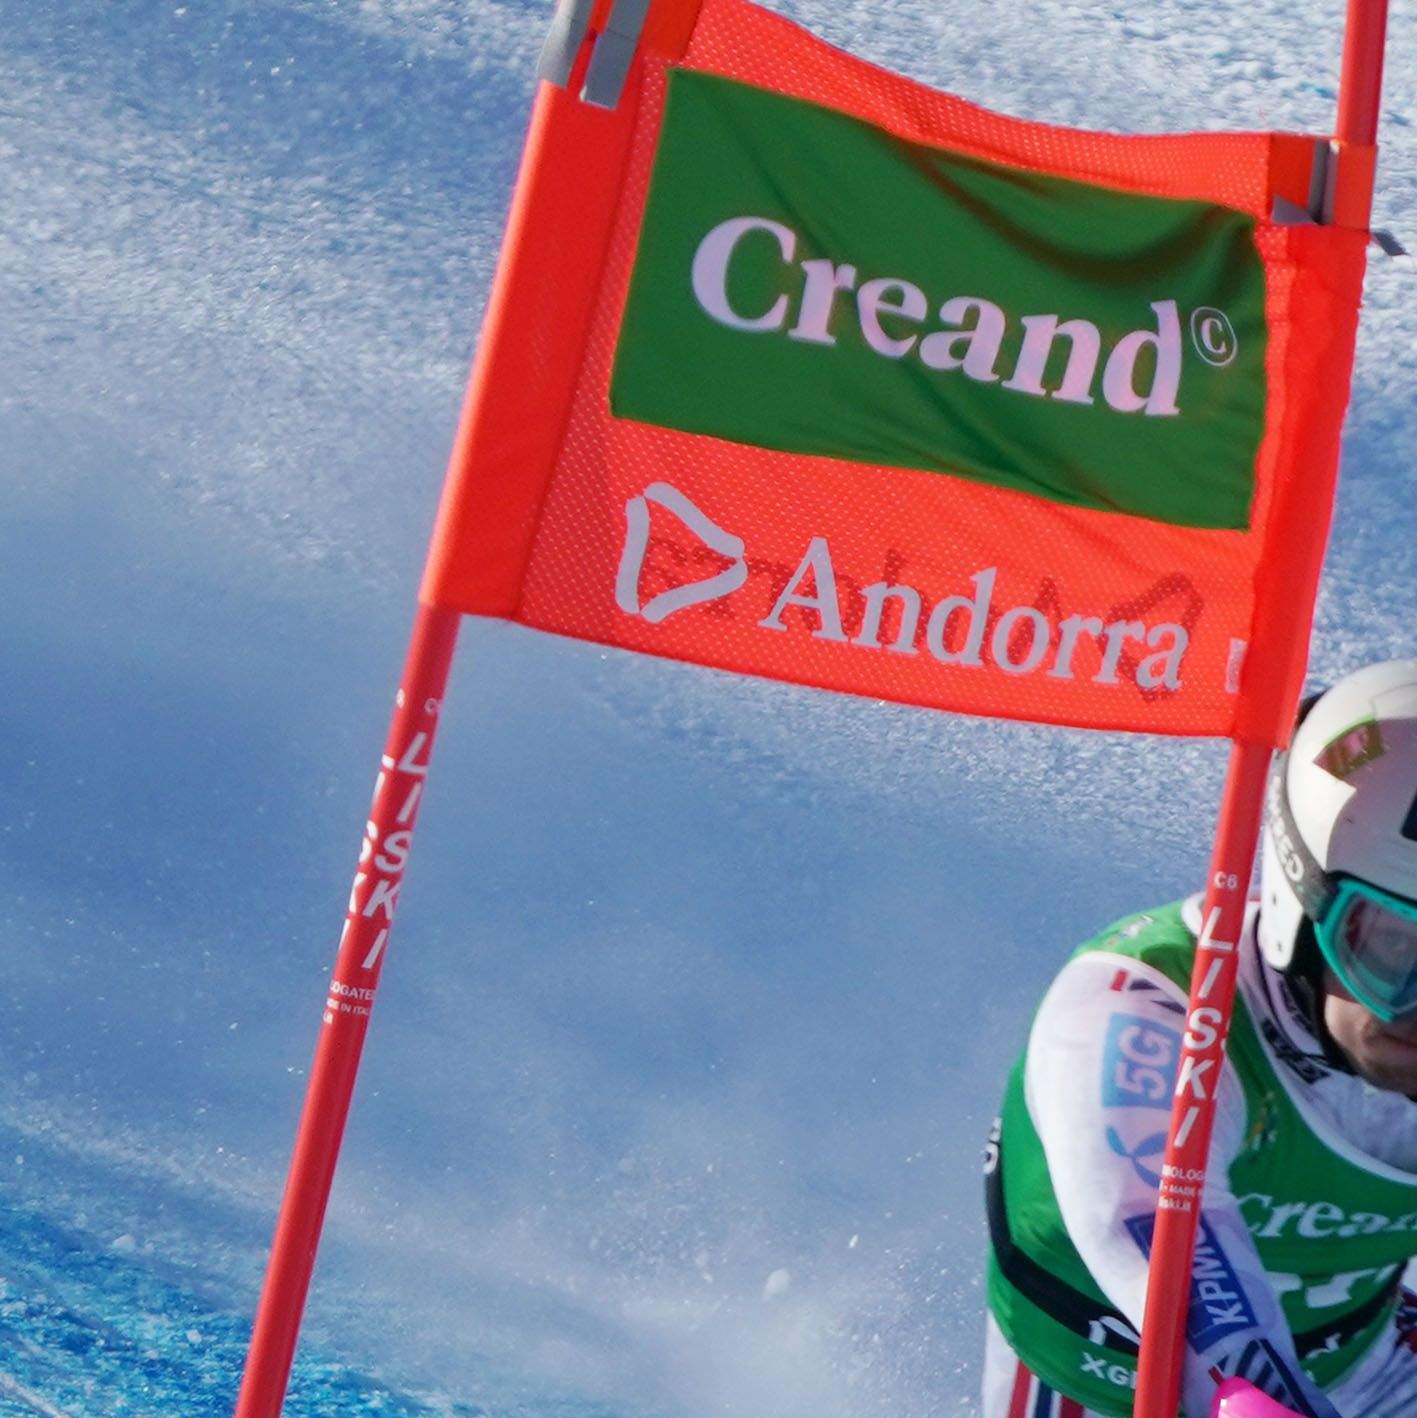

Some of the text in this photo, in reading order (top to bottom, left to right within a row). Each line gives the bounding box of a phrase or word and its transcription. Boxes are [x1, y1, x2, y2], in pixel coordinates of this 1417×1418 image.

[758, 536, 1192, 694] Andorra
[1114, 1024, 1173, 1100] 5G
[1174, 906, 1234, 1149] LISKI
